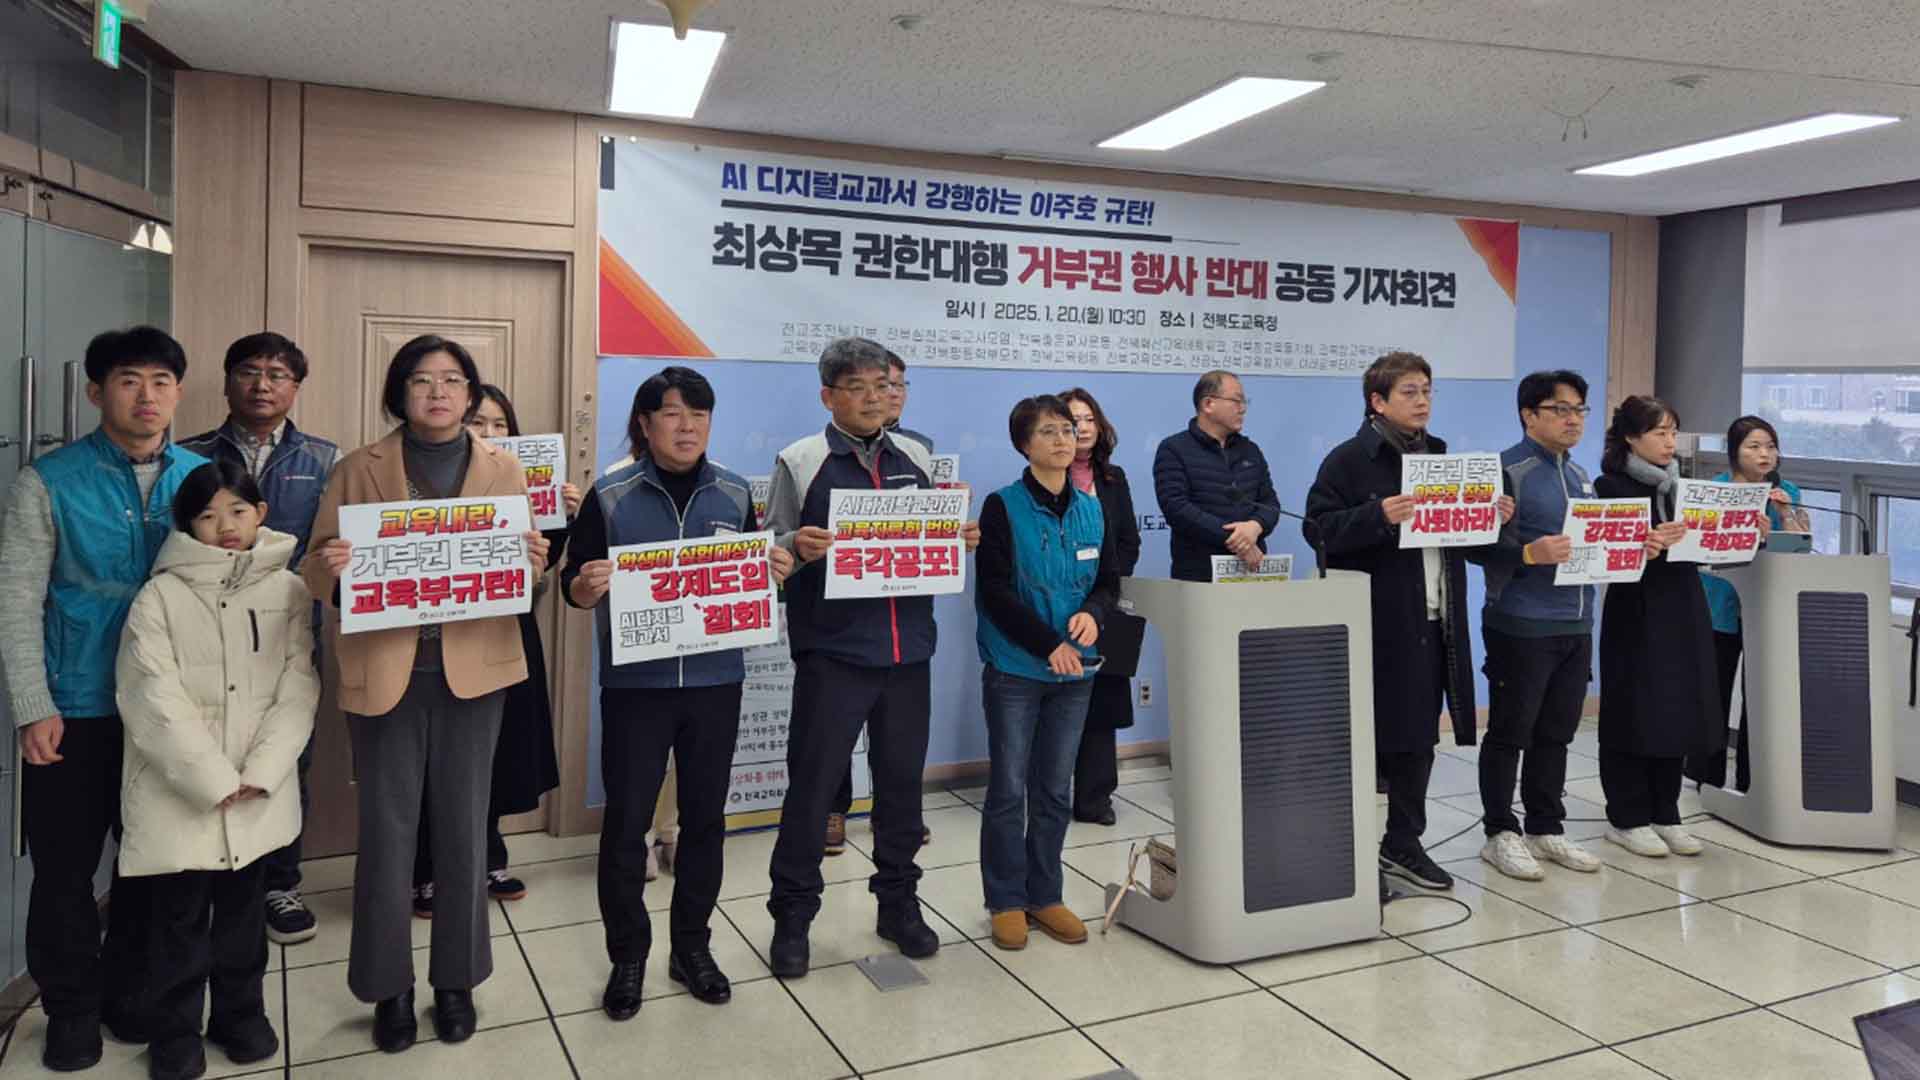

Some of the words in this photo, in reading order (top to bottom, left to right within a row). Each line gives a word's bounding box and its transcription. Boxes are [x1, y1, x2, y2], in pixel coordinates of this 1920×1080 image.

[722, 162, 747, 191] AI
[757, 166, 917, 207] 디지털교과서
[926, 182, 1022, 216] 강행하는
[1030, 192, 1098, 221] 이주호
[1105, 198, 1155, 226] 규탄!
[712, 222, 842, 276] 최상목
[852, 232, 1009, 287] 권한대행
[1017, 245, 1122, 293] 거부권
[1131, 251, 1198, 296] 행사
[1205, 257, 1268, 300] 반대
[1275, 262, 1336, 304] 공동
[1343, 266, 1456, 309] 기자회견
[945, 300, 975, 319] 일시
[1109, 309, 1146, 326] 10:30
[1159, 310, 1186, 328] 장소
[1202, 312, 1278, 332] 전북도교육청
[1409, 459, 1463, 482] 거부권
[378, 503, 509, 538] 교육내란,
[834, 519, 922, 541] 교육자료화
[925, 519, 961, 539] 법안
[1411, 507, 1496, 533] 사퇴하라!
[1584, 521, 1648, 542] 강제도입
[352, 541, 450, 578] 거부권
[460, 534, 522, 567] 폭주
[834, 545, 959, 579] 즉각공포!
[351, 568, 525, 614] 교육부규탄!
[651, 561, 769, 602] 강제도입
[703, 598, 771, 636] 철회!
